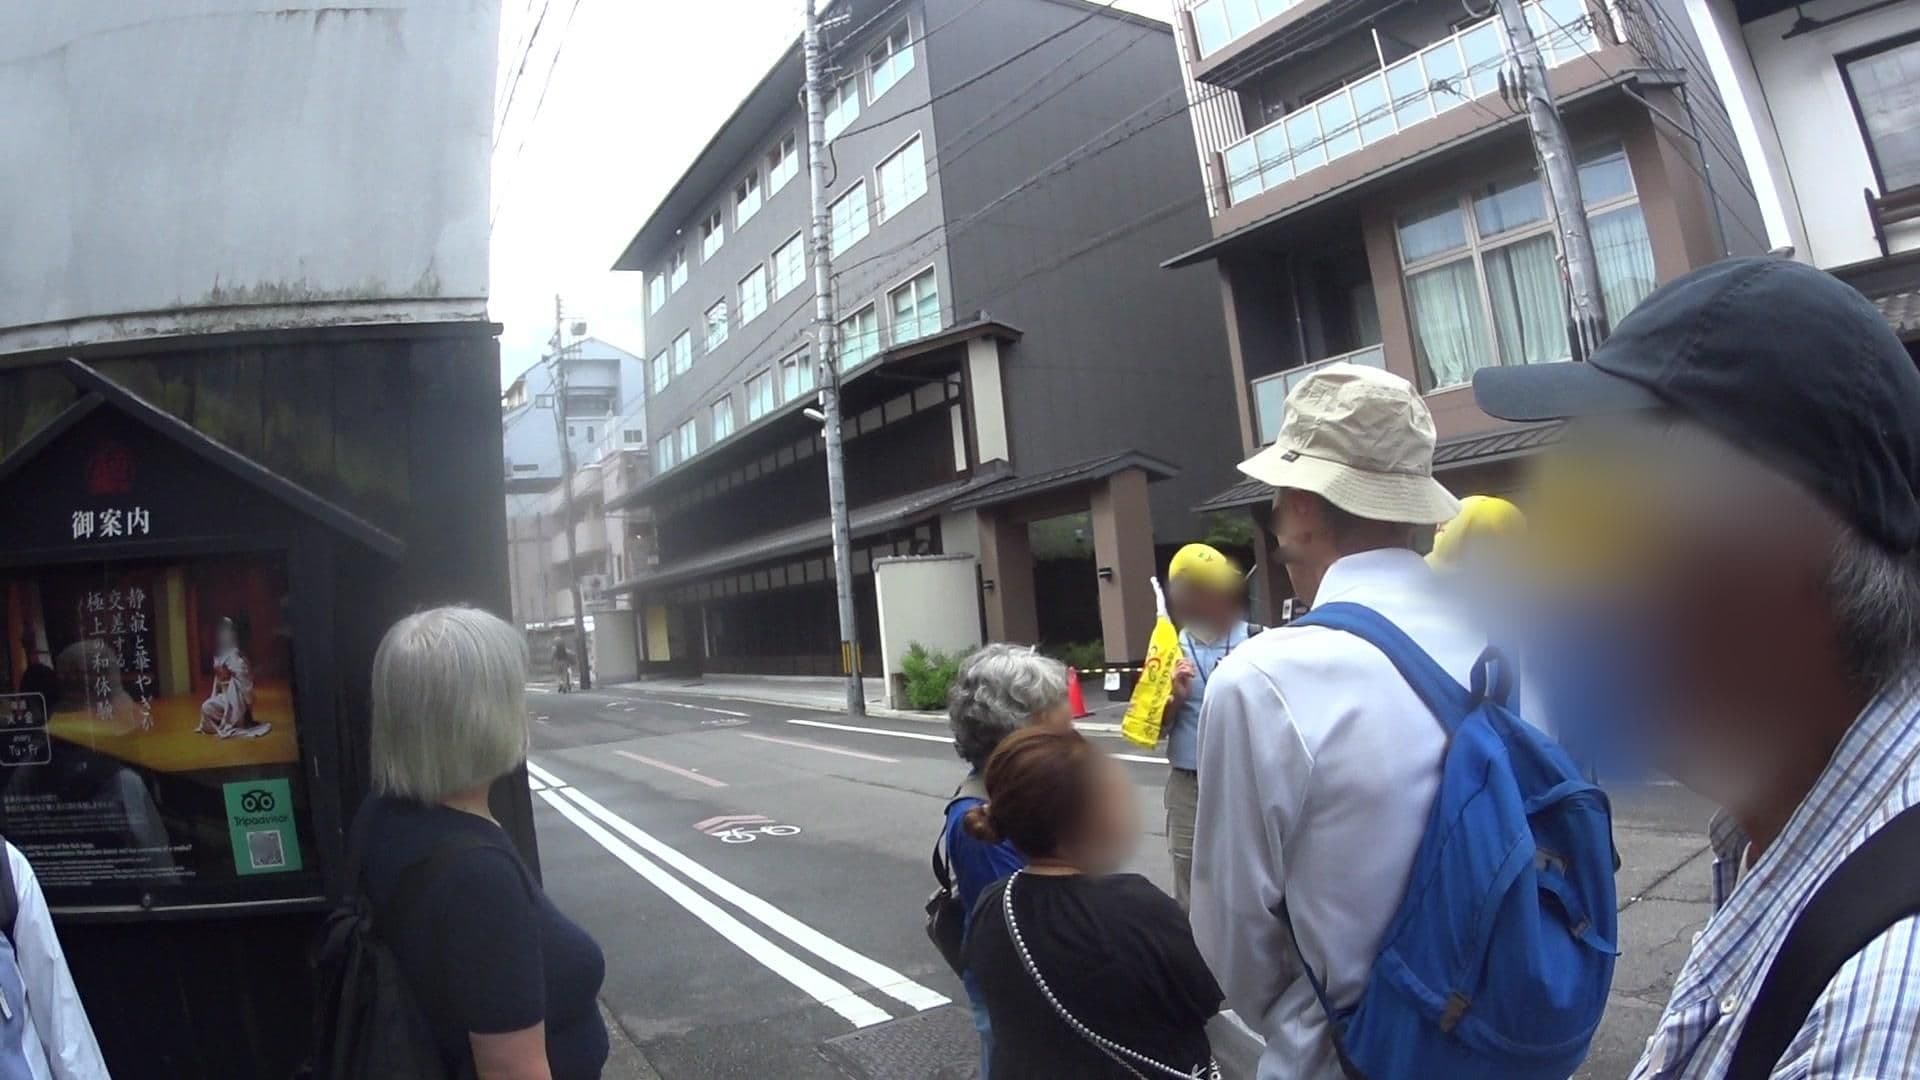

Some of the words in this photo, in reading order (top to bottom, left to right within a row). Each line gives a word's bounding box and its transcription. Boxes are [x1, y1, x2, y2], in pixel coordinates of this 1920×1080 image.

[72, 507, 150, 539] 御案内
[233, 814, 288, 827] Tripadvisor
